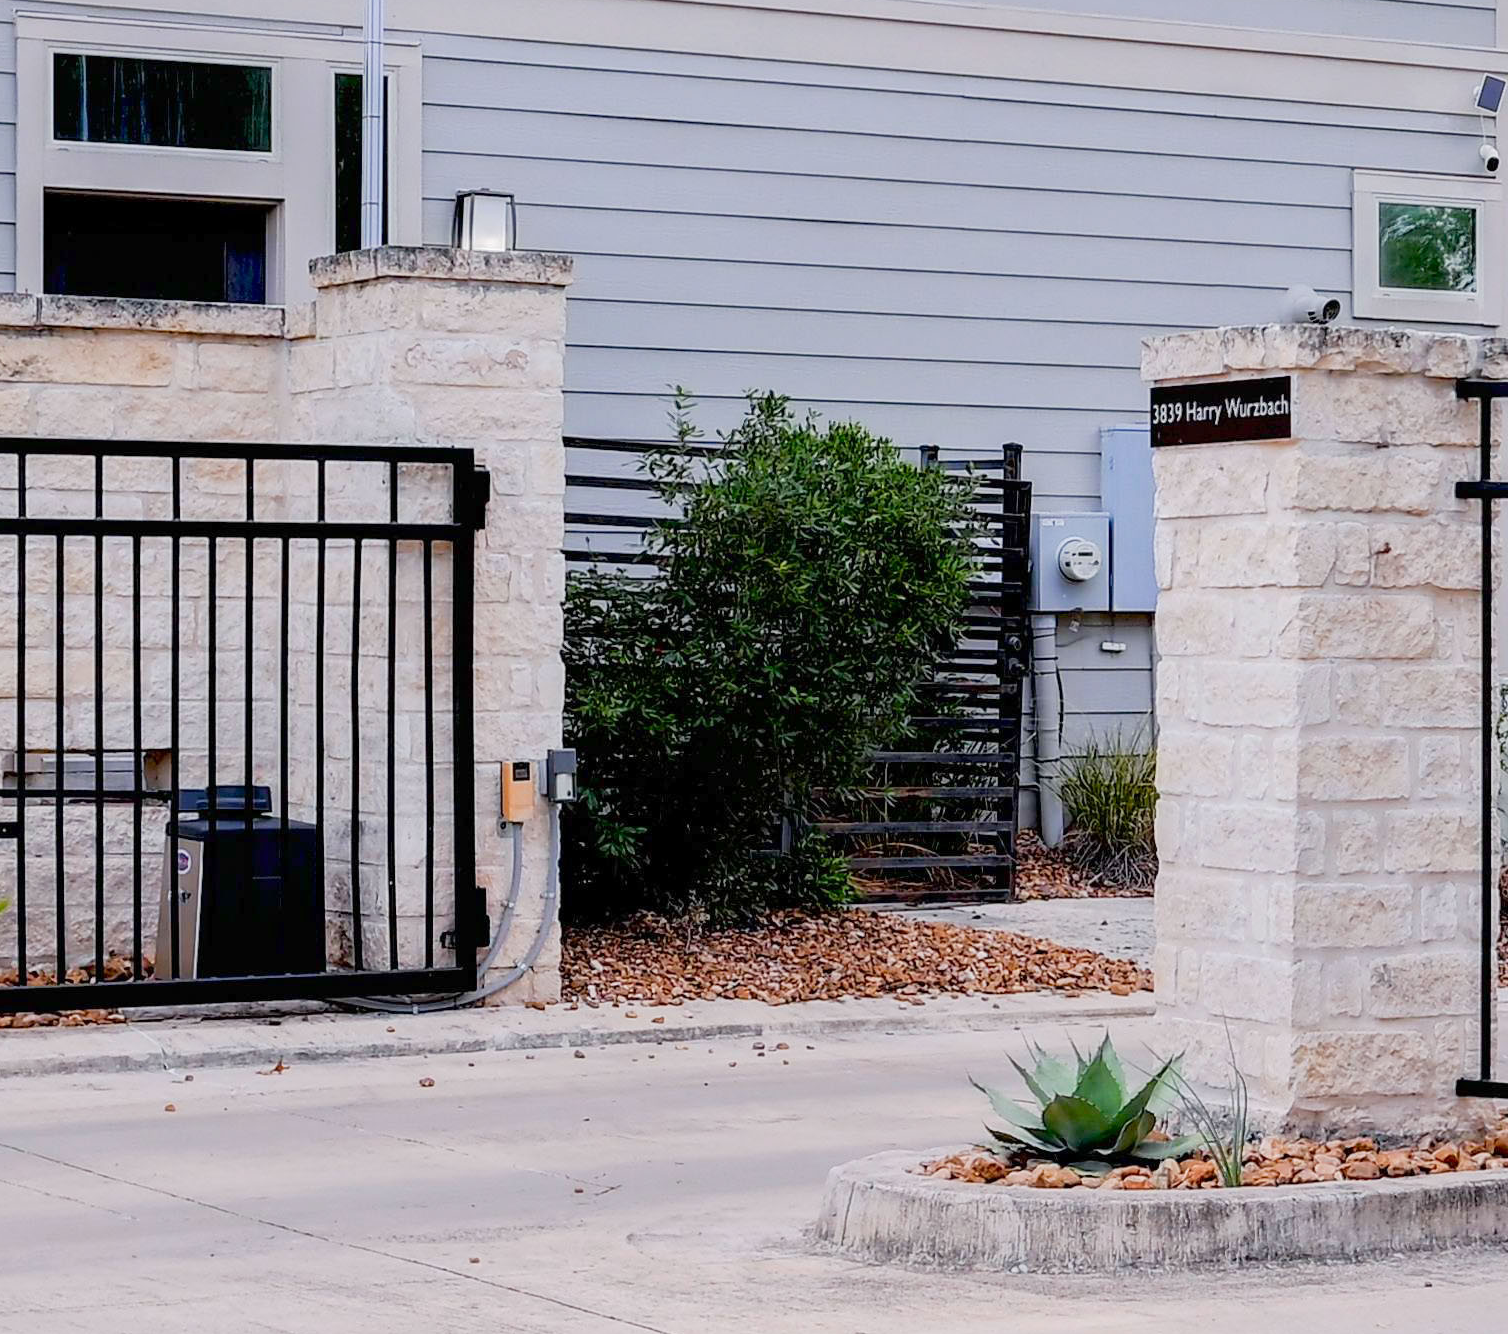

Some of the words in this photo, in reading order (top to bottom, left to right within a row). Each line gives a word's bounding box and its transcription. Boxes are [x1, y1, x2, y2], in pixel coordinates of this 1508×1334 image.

[1152, 402, 1183, 425] 3839
[1186, 401, 1222, 426] Harry
[1224, 394, 1289, 419] Wurzbach
